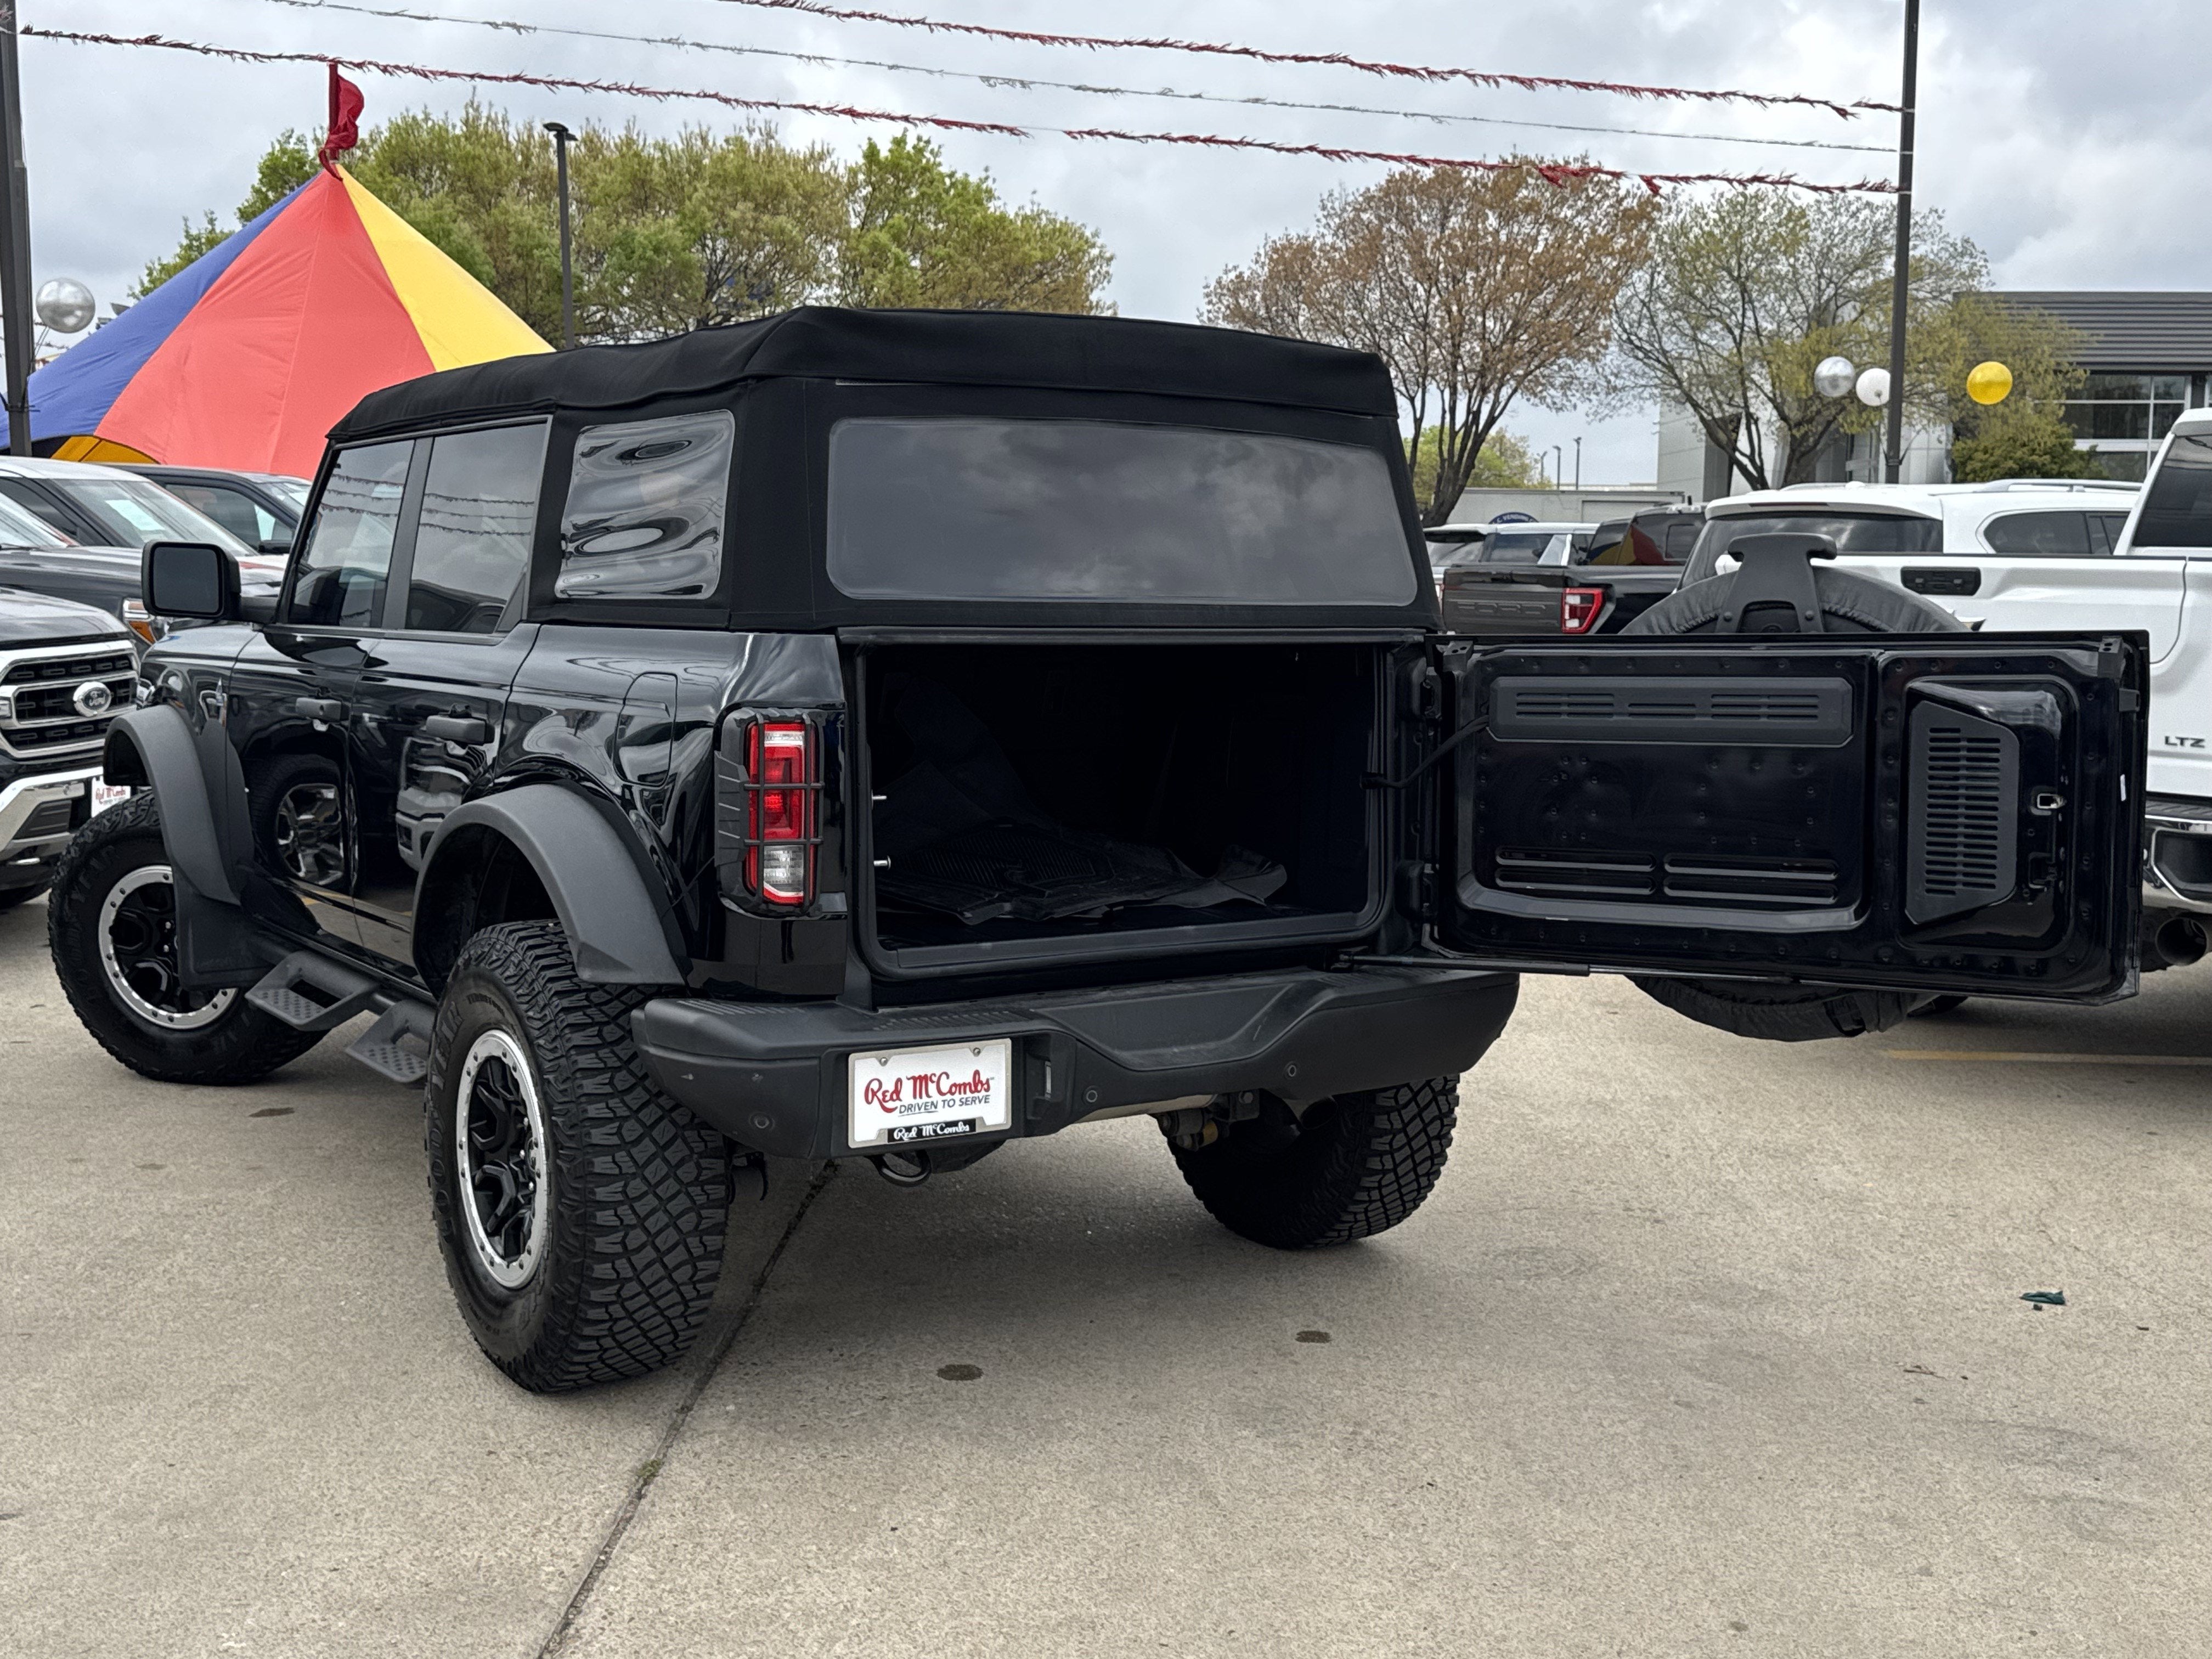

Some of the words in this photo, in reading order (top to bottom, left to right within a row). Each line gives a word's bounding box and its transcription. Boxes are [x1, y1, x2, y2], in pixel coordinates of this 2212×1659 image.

[2164, 736, 2205, 748] LTZ
[864, 1077, 902, 1113] Red
[906, 1069, 990, 1099] McCombs
[899, 1100, 938, 1114] DRIVEN
[941, 1098, 956, 1109] TO
[958, 1094, 991, 1107] SERVE
[430, 1001, 463, 1243] GOODYEAR
[894, 1127, 917, 1141] Red
[919, 1121, 970, 1137] McCombs
